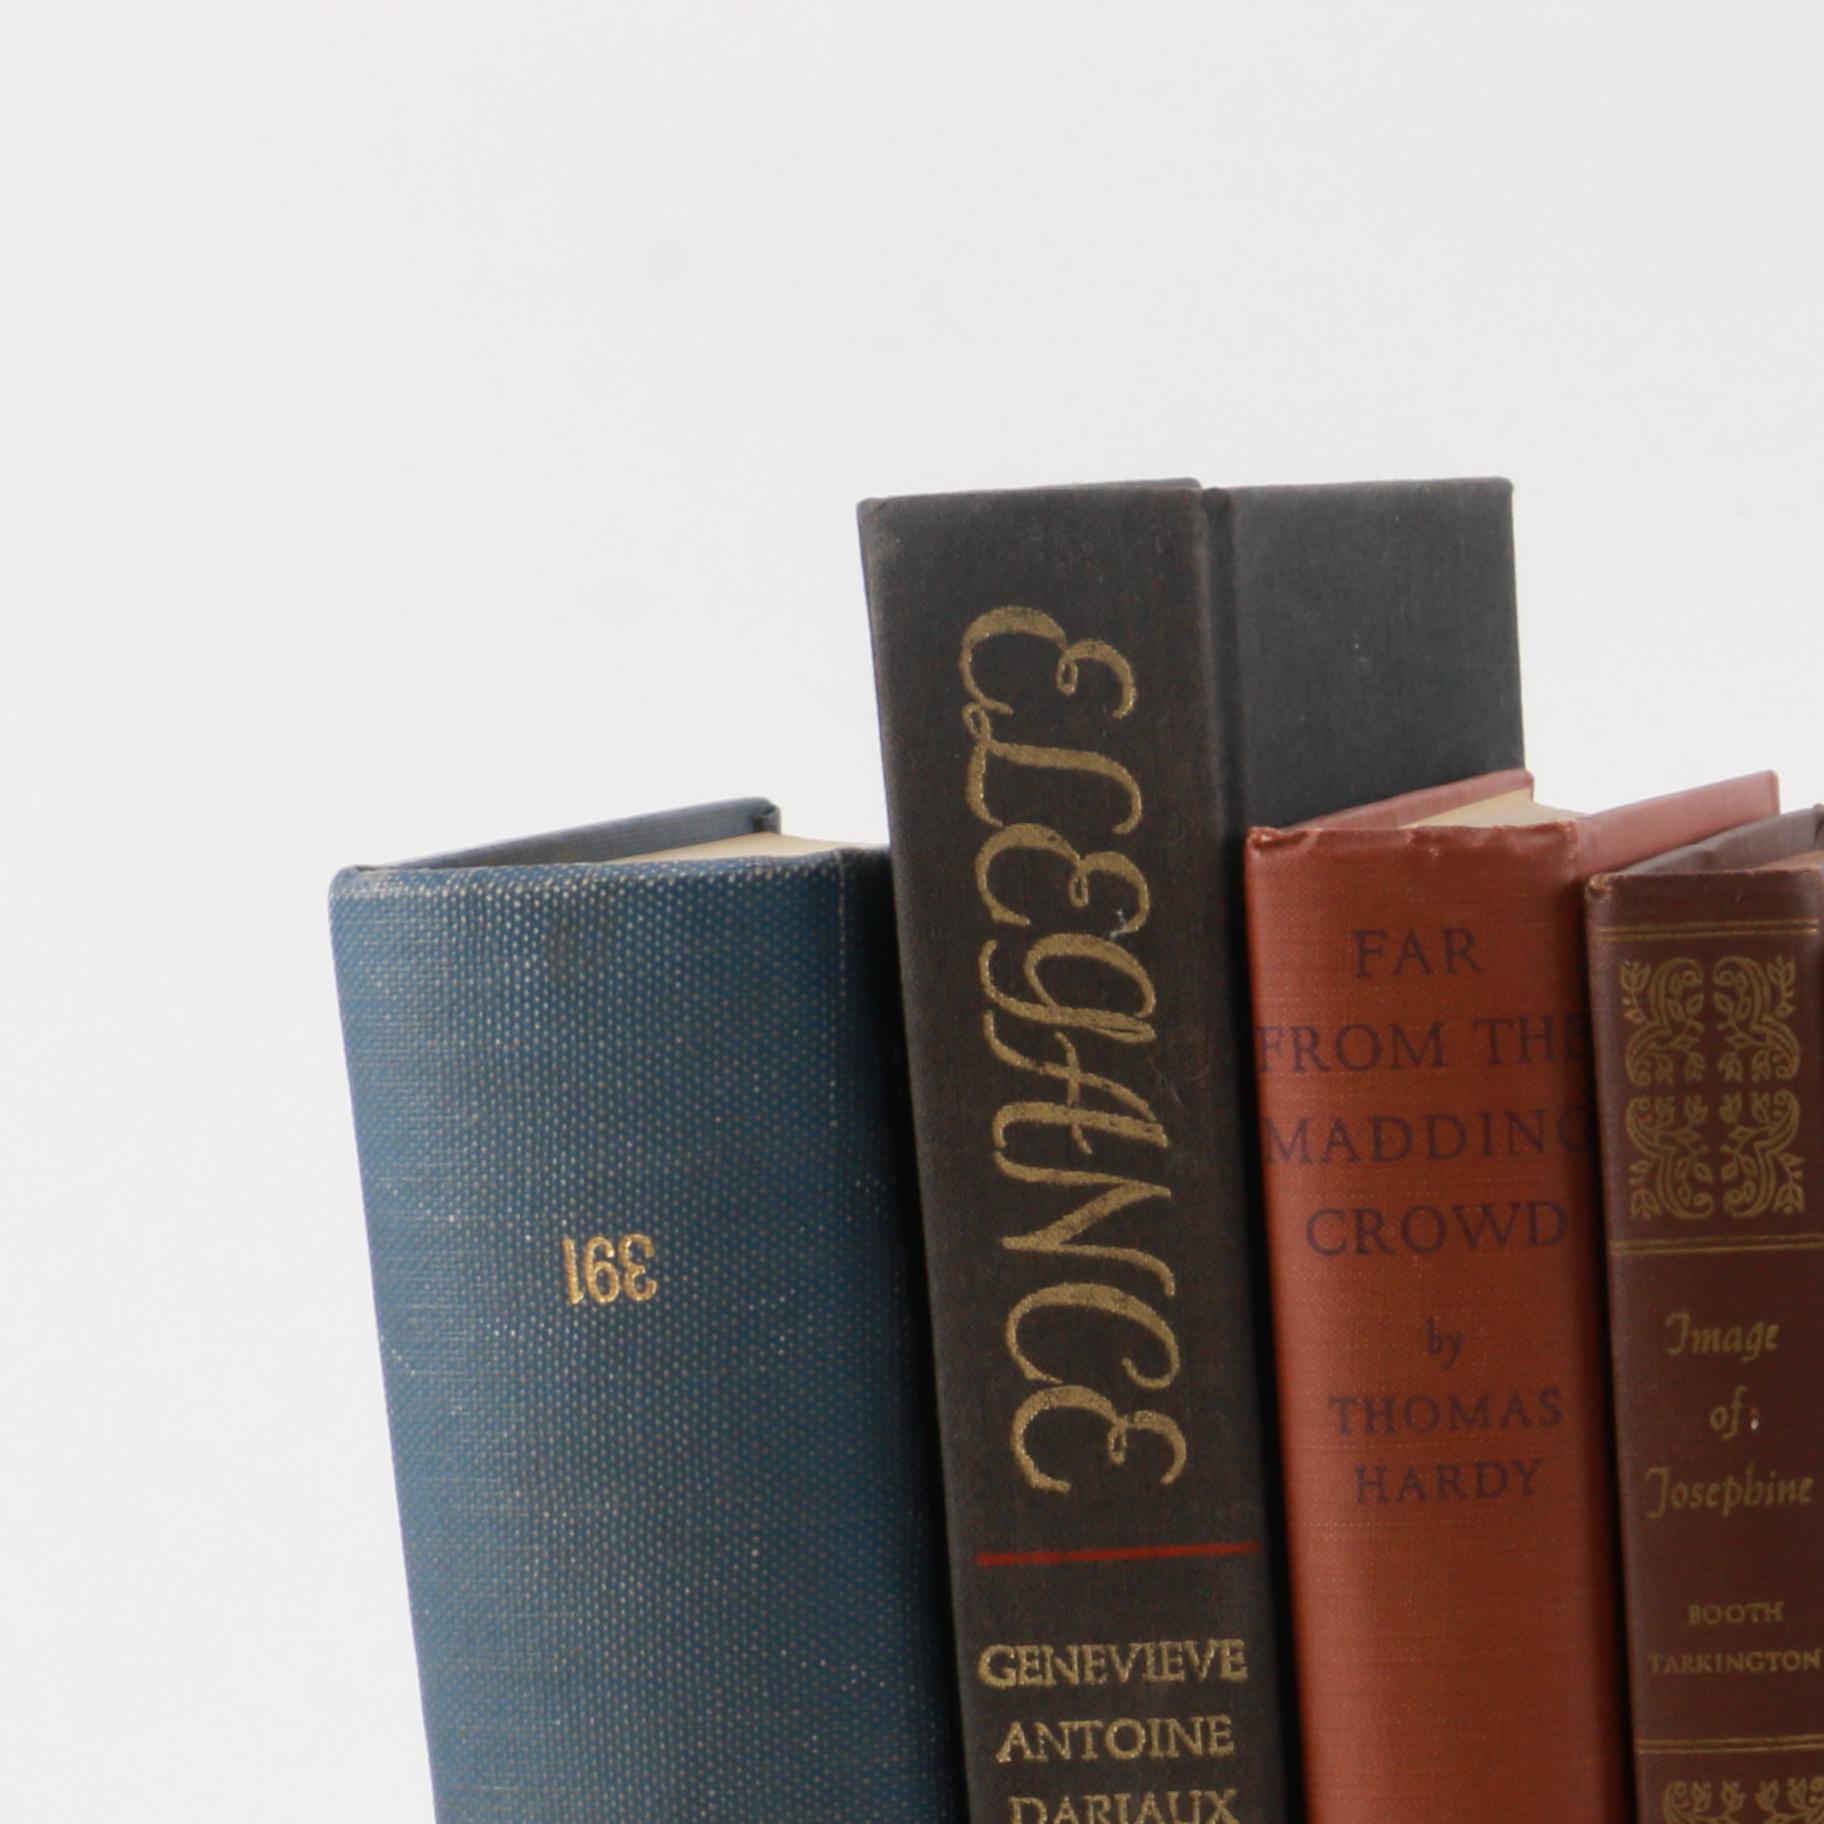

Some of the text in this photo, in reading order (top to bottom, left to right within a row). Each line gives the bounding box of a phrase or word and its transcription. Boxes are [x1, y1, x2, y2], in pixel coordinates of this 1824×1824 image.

[1353, 928, 1484, 978] FAR
[960, 606, 1187, 1492] ELEGANCE
[1258, 1022, 1446, 1074] FROM
[1306, 1202, 1568, 1257] CROWD
[1426, 1317, 1462, 1370] by
[1665, 1312, 1780, 1362] Image
[1328, 1387, 1564, 1435] THOMAS
[1710, 1386, 1748, 1440] of
[1354, 1457, 1542, 1504] HARDY
[1645, 1463, 1814, 1518] Josephine
[1688, 1602, 1784, 1625] BOOTH
[976, 1638, 1248, 1688] GENEVIEVE
[1649, 1648, 1822, 1675] TARKINGTON
[995, 1714, 1235, 1763] ANTOINE
